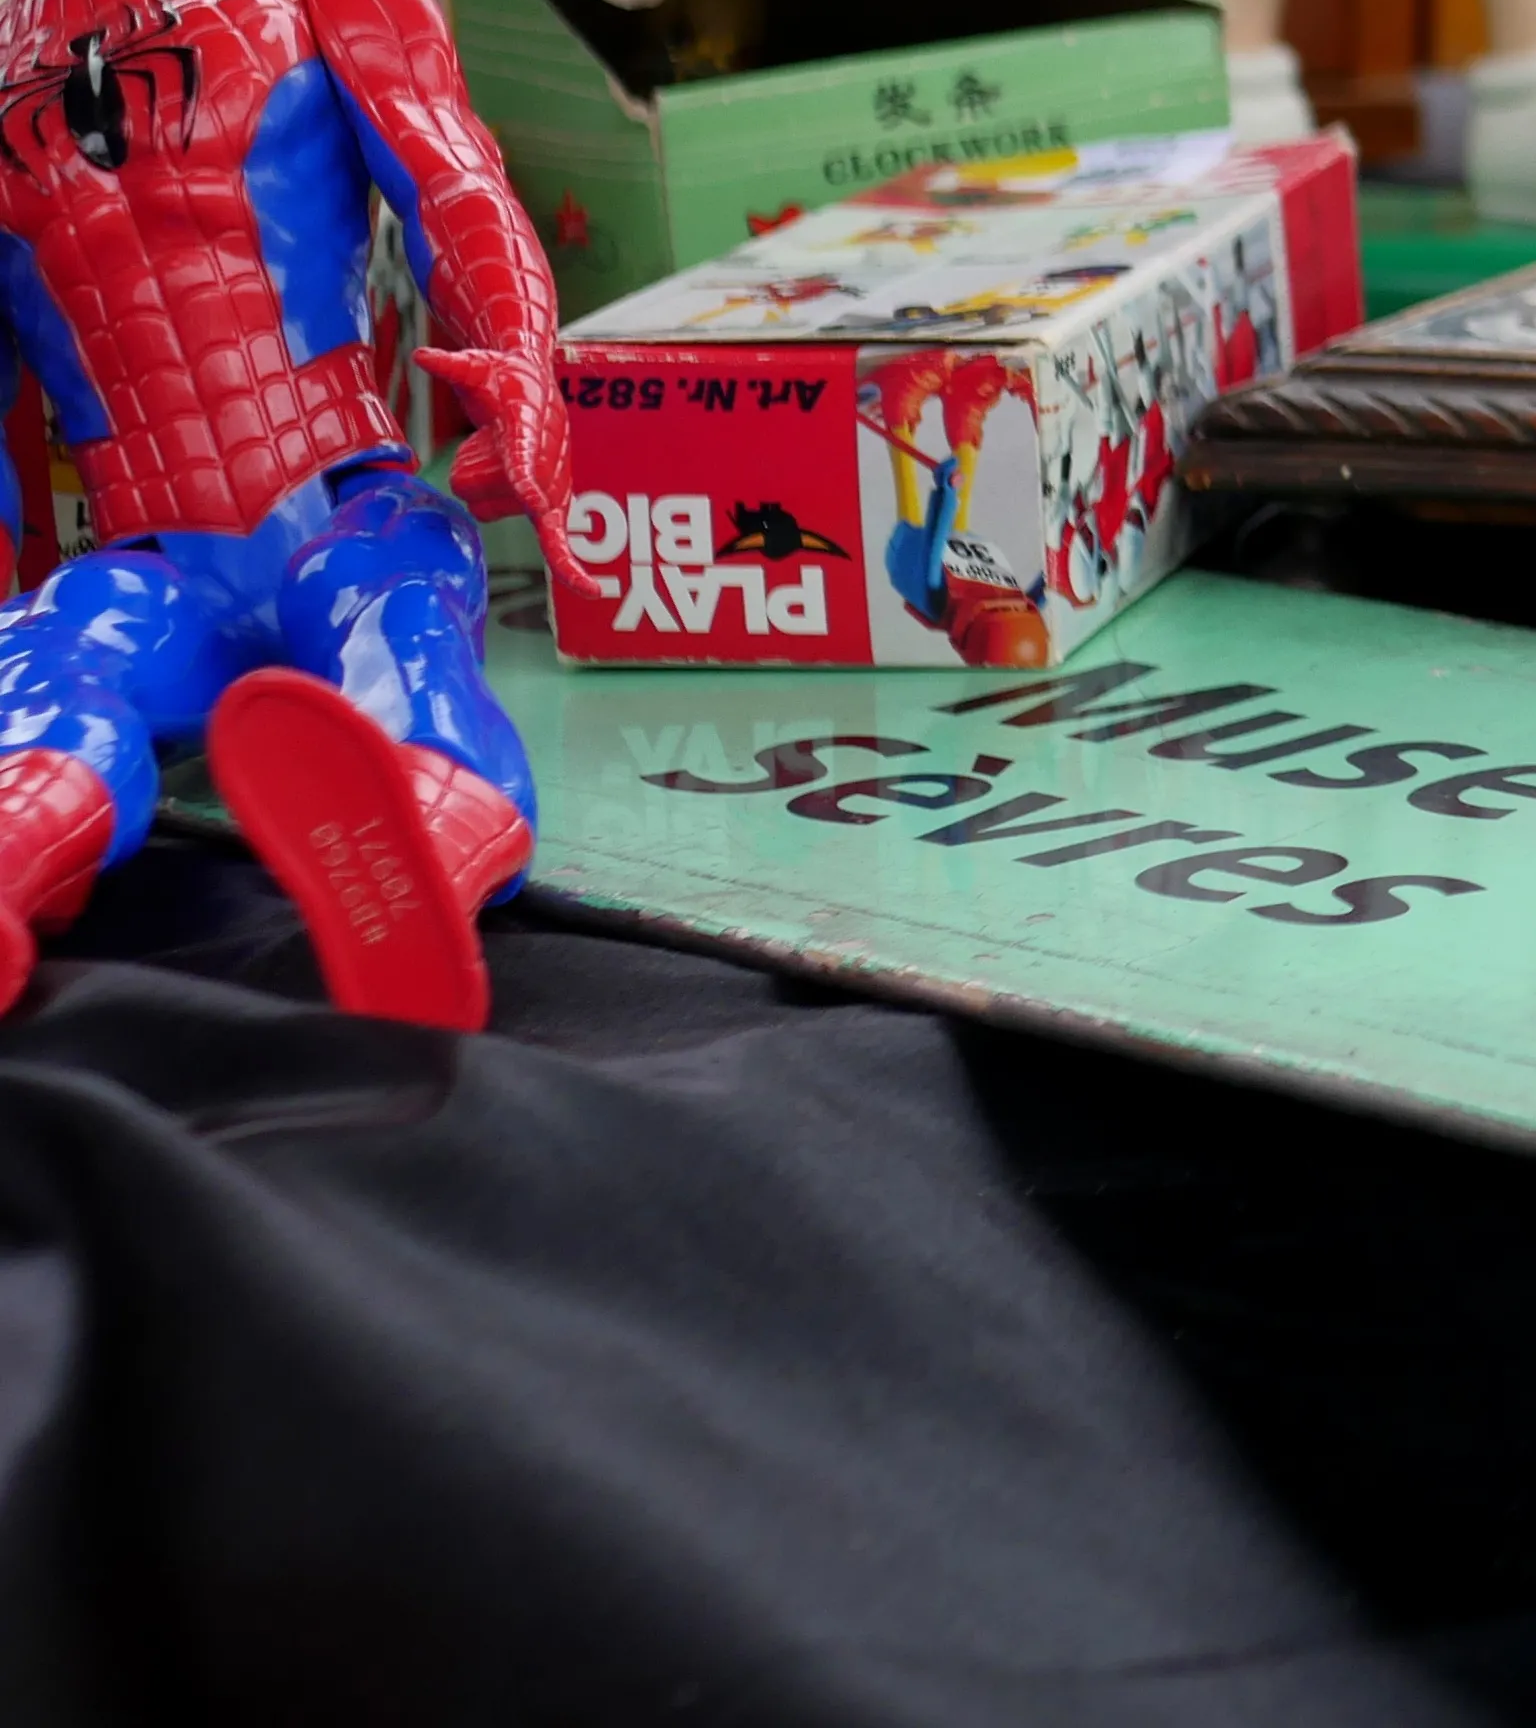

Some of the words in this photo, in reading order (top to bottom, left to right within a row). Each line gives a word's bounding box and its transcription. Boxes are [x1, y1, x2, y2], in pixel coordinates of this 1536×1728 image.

[822, 117, 1072, 185] CLOCKWORK
[677, 377, 738, 412] Nr.
[747, 376, 828, 413] Art.
[566, 490, 714, 565] BIG
[639, 734, 1488, 927] Sèvres
